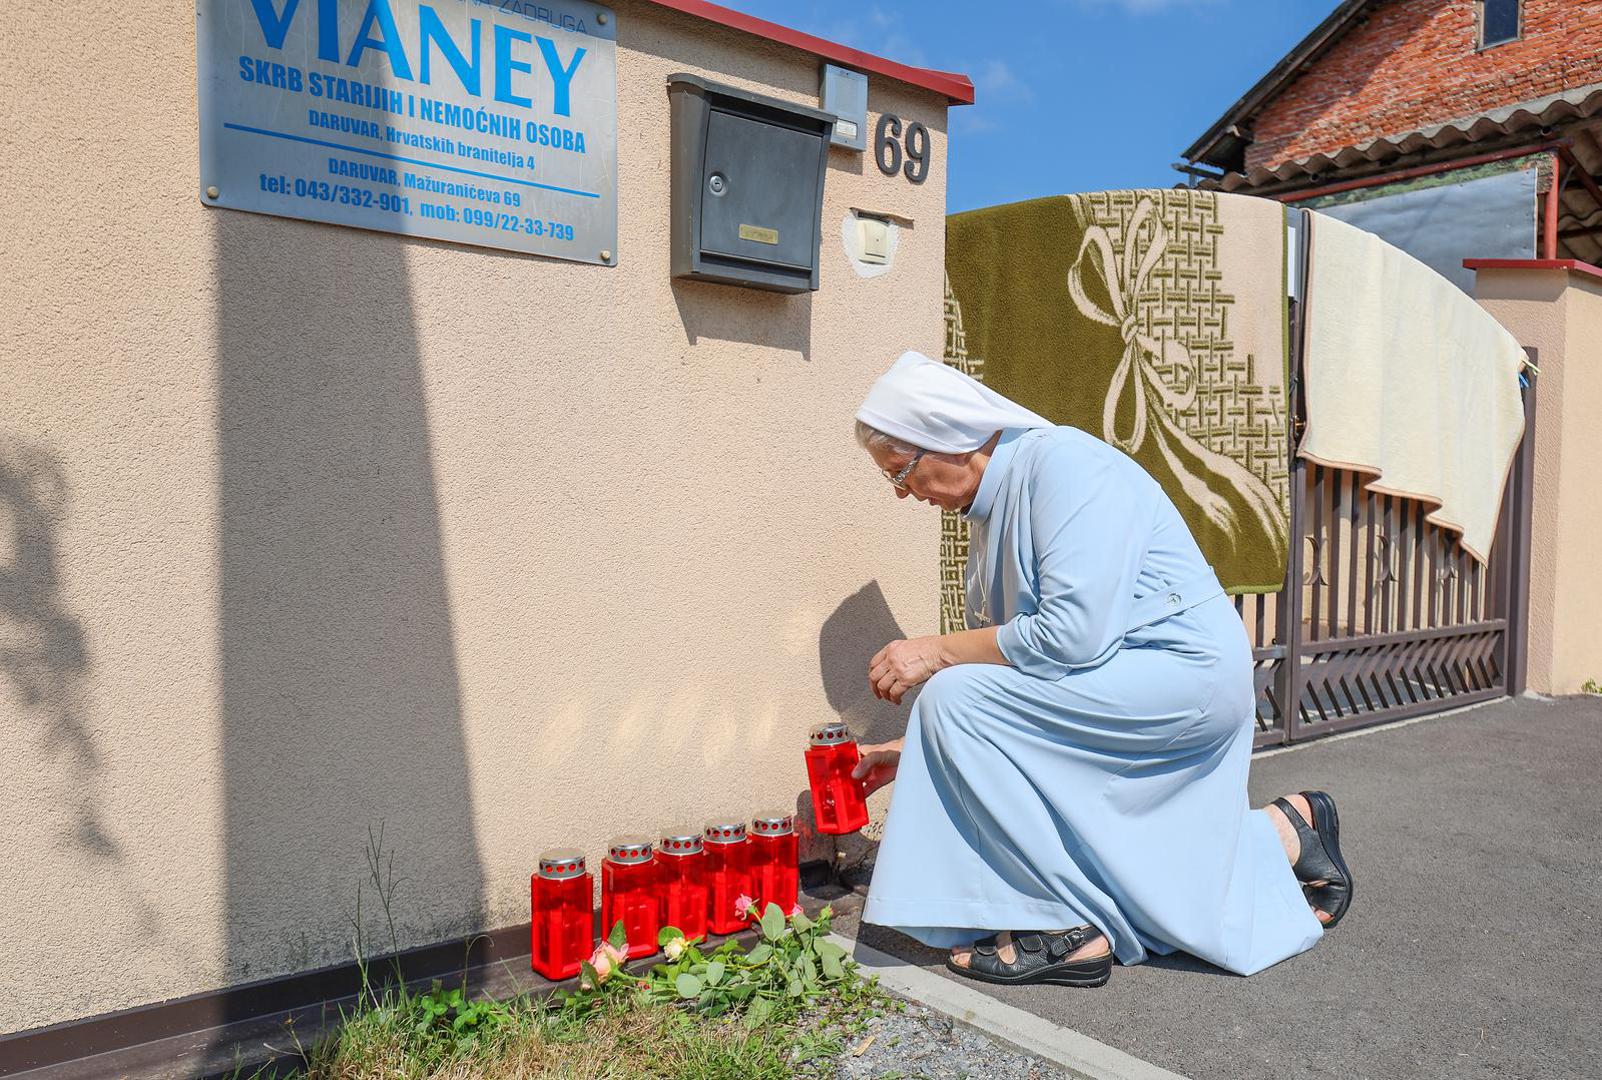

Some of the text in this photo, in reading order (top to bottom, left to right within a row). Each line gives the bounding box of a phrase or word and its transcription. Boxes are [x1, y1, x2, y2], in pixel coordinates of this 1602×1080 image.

[251, 0, 587, 118] VIANEY
[239, 55, 586, 154] SKRB STARIJIH I NEMOĆNIH OSOBA
[309, 109, 535, 170] DARUVAR, Hrvatskih branitelja 4
[875, 112, 931, 185] 69
[260, 174, 574, 241] tel: 043/332-901, mob: 099/22-33-739
[404, 172, 500, 204] Mažuranićeva
[503, 191, 521, 207] 69
